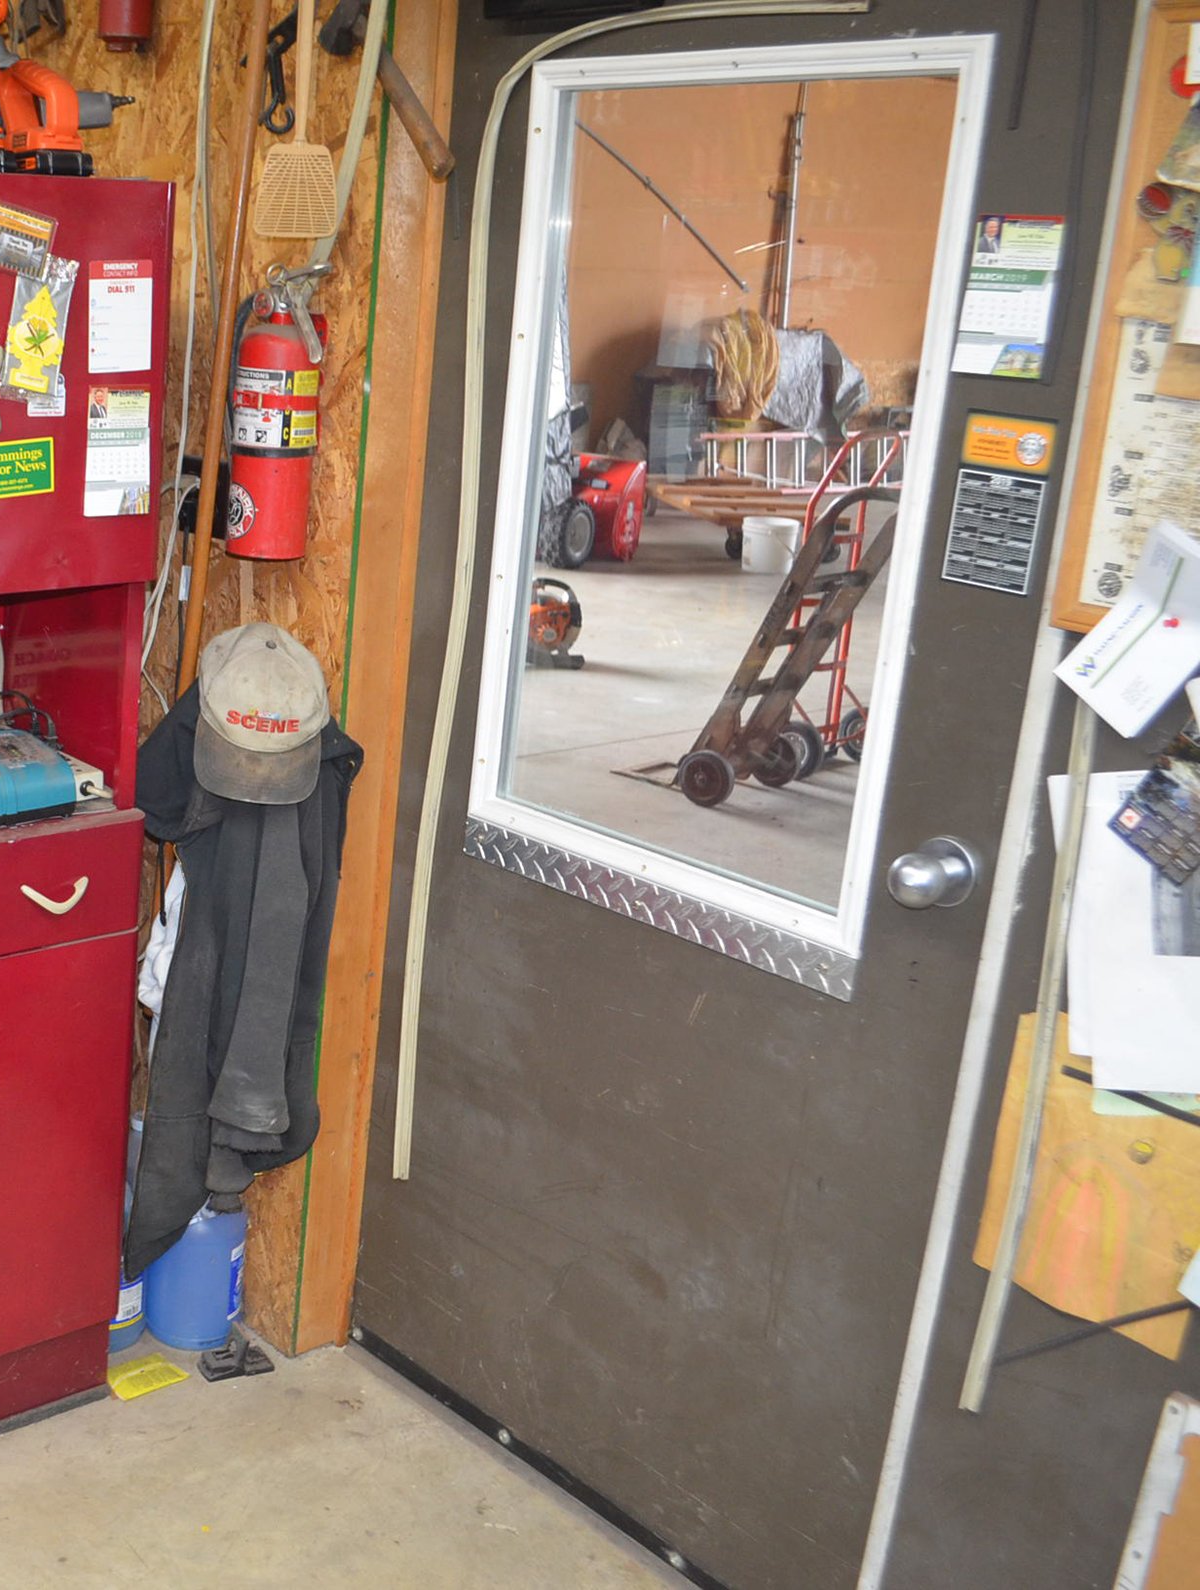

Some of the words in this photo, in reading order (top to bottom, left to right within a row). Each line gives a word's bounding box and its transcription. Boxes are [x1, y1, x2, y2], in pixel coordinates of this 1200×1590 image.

[108, 285, 122, 293] DIAL
[286, 378, 292, 390] A
[283, 427, 290, 440] C
[15, 460, 47, 473] News
[226, 710, 300, 733] SCENE
